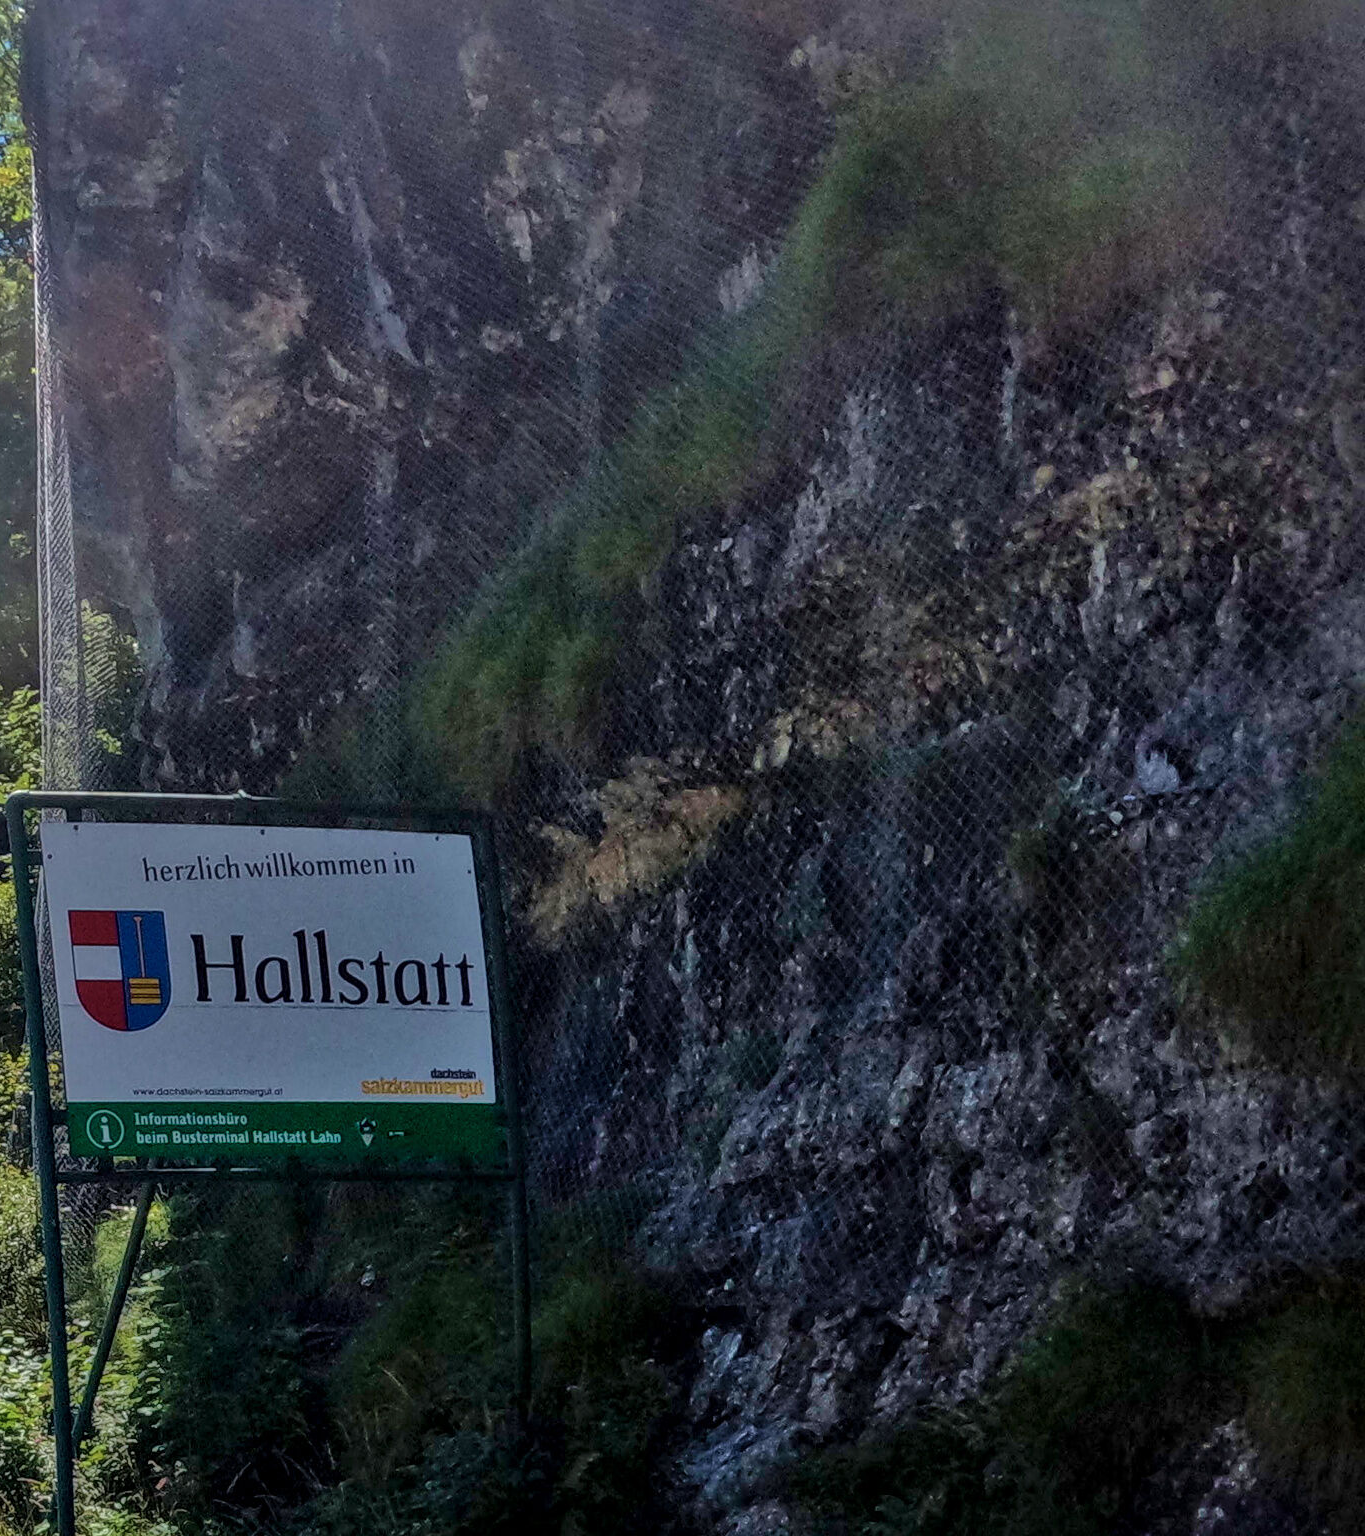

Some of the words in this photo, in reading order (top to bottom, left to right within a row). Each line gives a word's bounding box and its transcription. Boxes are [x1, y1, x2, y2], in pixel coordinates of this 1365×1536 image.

[142, 854, 241, 882] herzlich
[244, 851, 387, 878] willkommen
[393, 851, 415, 875] in
[190, 929, 475, 1006] Hallstatt
[431, 1068, 476, 1079] dachstein
[361, 1077, 485, 1099] salzkammergut
[134, 1112, 248, 1126] Informationsbüro
[136, 1130, 169, 1144] beim
[172, 1130, 250, 1144] Busterminal
[253, 1129, 307, 1144] Hallstatt
[310, 1130, 342, 1145] Lahn
